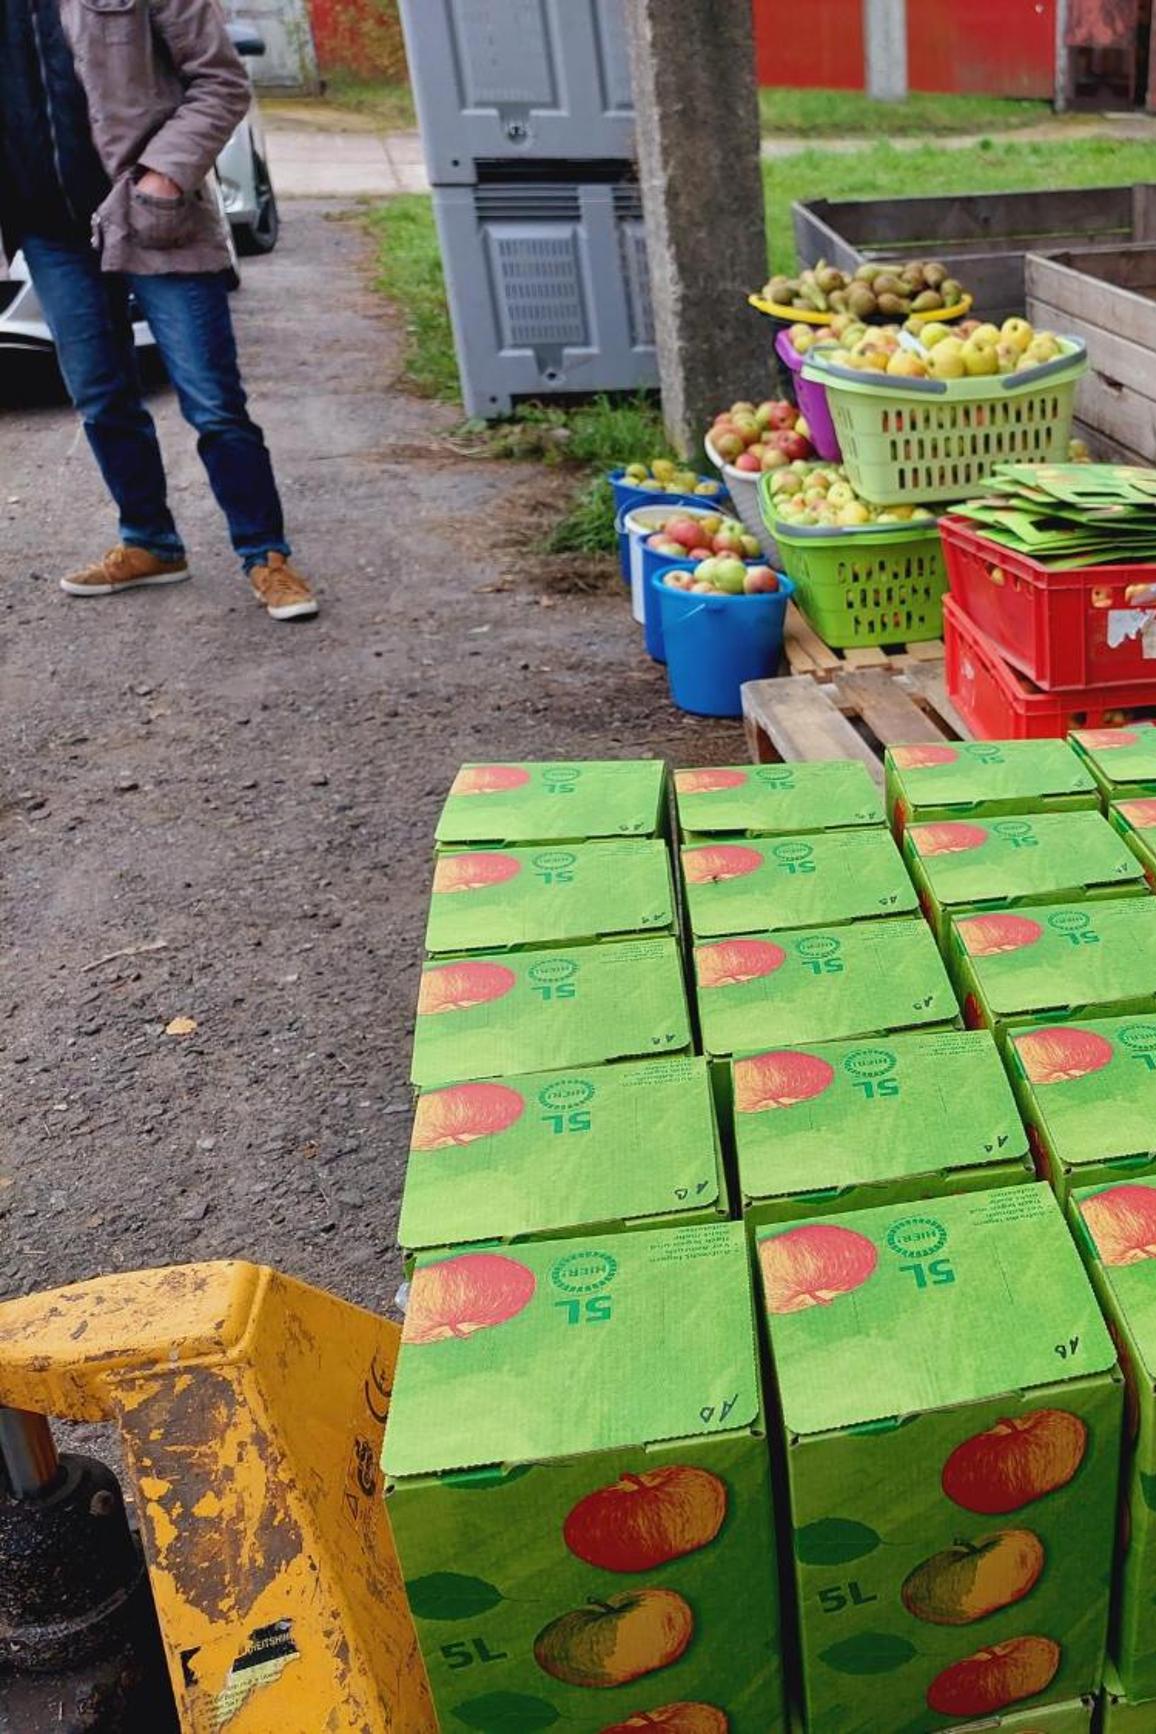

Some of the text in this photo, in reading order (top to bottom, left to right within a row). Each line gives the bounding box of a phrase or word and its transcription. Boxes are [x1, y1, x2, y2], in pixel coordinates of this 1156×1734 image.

[1003, 836, 1038, 848] 5L
[536, 869, 574, 883] 5L
[777, 861, 816, 874] 5L
[1059, 931, 1099, 945] 5L
[802, 958, 843, 975] 5L
[532, 983, 575, 1000] 5L
[852, 1078, 899, 1099] 5L
[541, 1110, 591, 1133] 5L
[897, 1229, 936, 1244] HIER!
[900, 1259, 955, 1289] 5L
[555, 1296, 612, 1324] 5L
[818, 1580, 877, 1613] 5L
[439, 1635, 508, 1671] 5L
